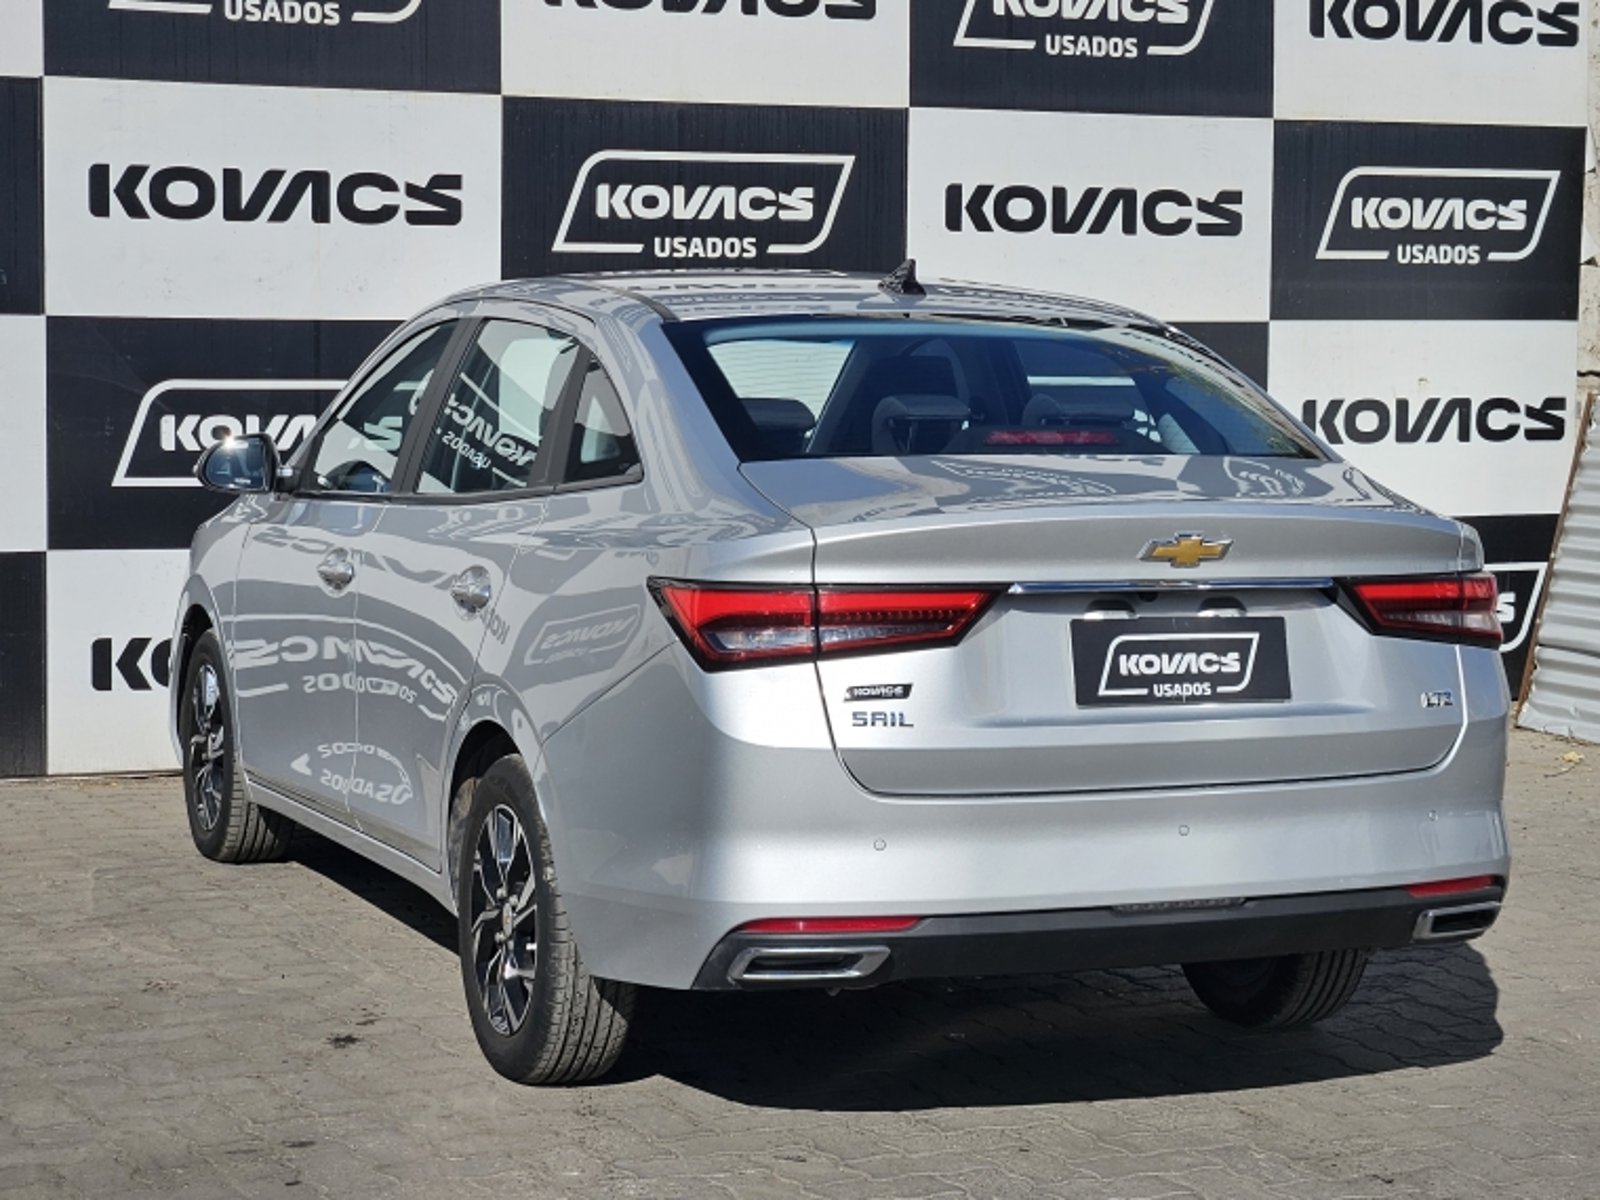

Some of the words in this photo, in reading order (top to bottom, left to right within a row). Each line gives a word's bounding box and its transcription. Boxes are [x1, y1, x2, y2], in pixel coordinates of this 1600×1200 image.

[225, 0, 340, 25] USADOS
[1310, 0, 1579, 46] KOVACS
[1046, 34, 1137, 57] USADOS
[89, 164, 462, 225] KOVACS
[595, 183, 815, 223] KOVACS
[946, 184, 1242, 236] KOVACS
[1351, 197, 1526, 230] KOVACS
[655, 237, 756, 258] USADOS
[1397, 244, 1480, 264] USADOS
[1302, 396, 1567, 444] KOVACS
[1118, 650, 1241, 676] KOVACS
[1153, 682, 1212, 697] USADOS
[852, 711, 914, 727] SAIL
